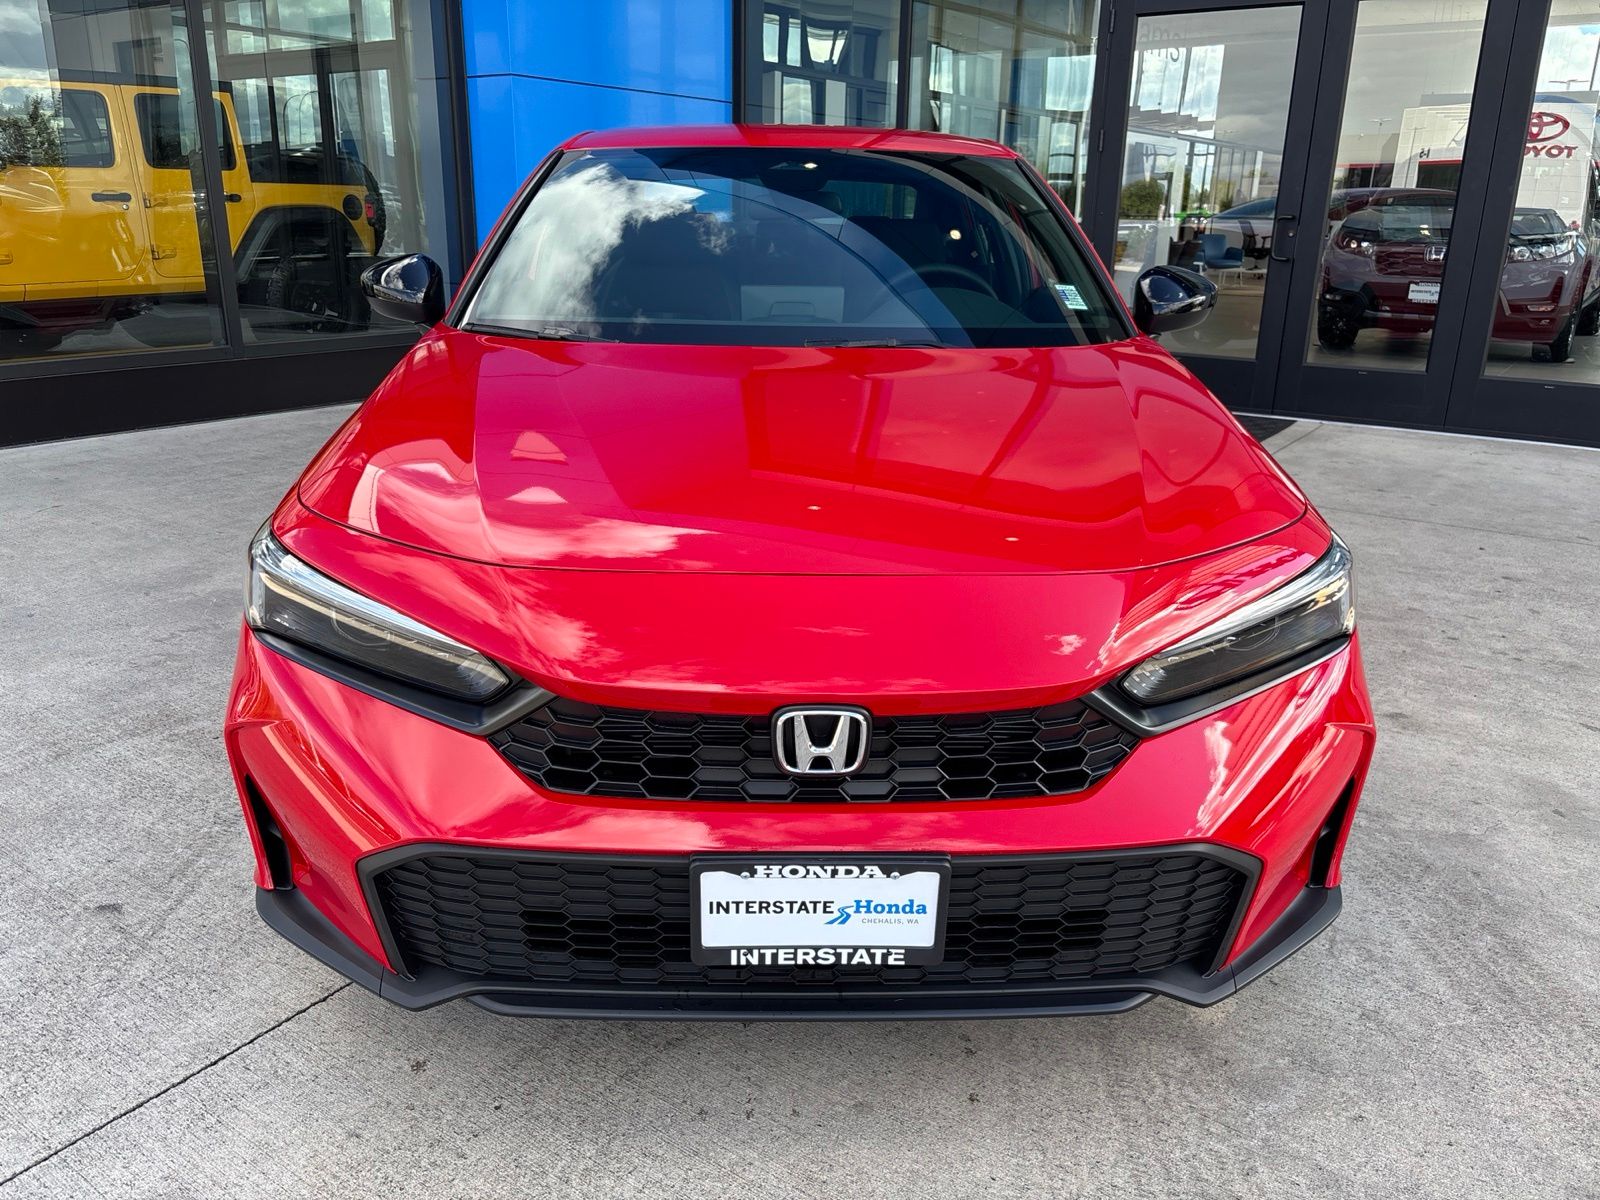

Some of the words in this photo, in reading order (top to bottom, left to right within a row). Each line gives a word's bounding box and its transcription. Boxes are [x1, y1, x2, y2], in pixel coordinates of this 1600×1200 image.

[754, 864, 886, 879] HONDA
[709, 900, 834, 915] INTERSTATE
[853, 899, 928, 915] Honda
[862, 918, 905, 926] CHEHALIS,
[730, 948, 906, 966] INTERSTATE
